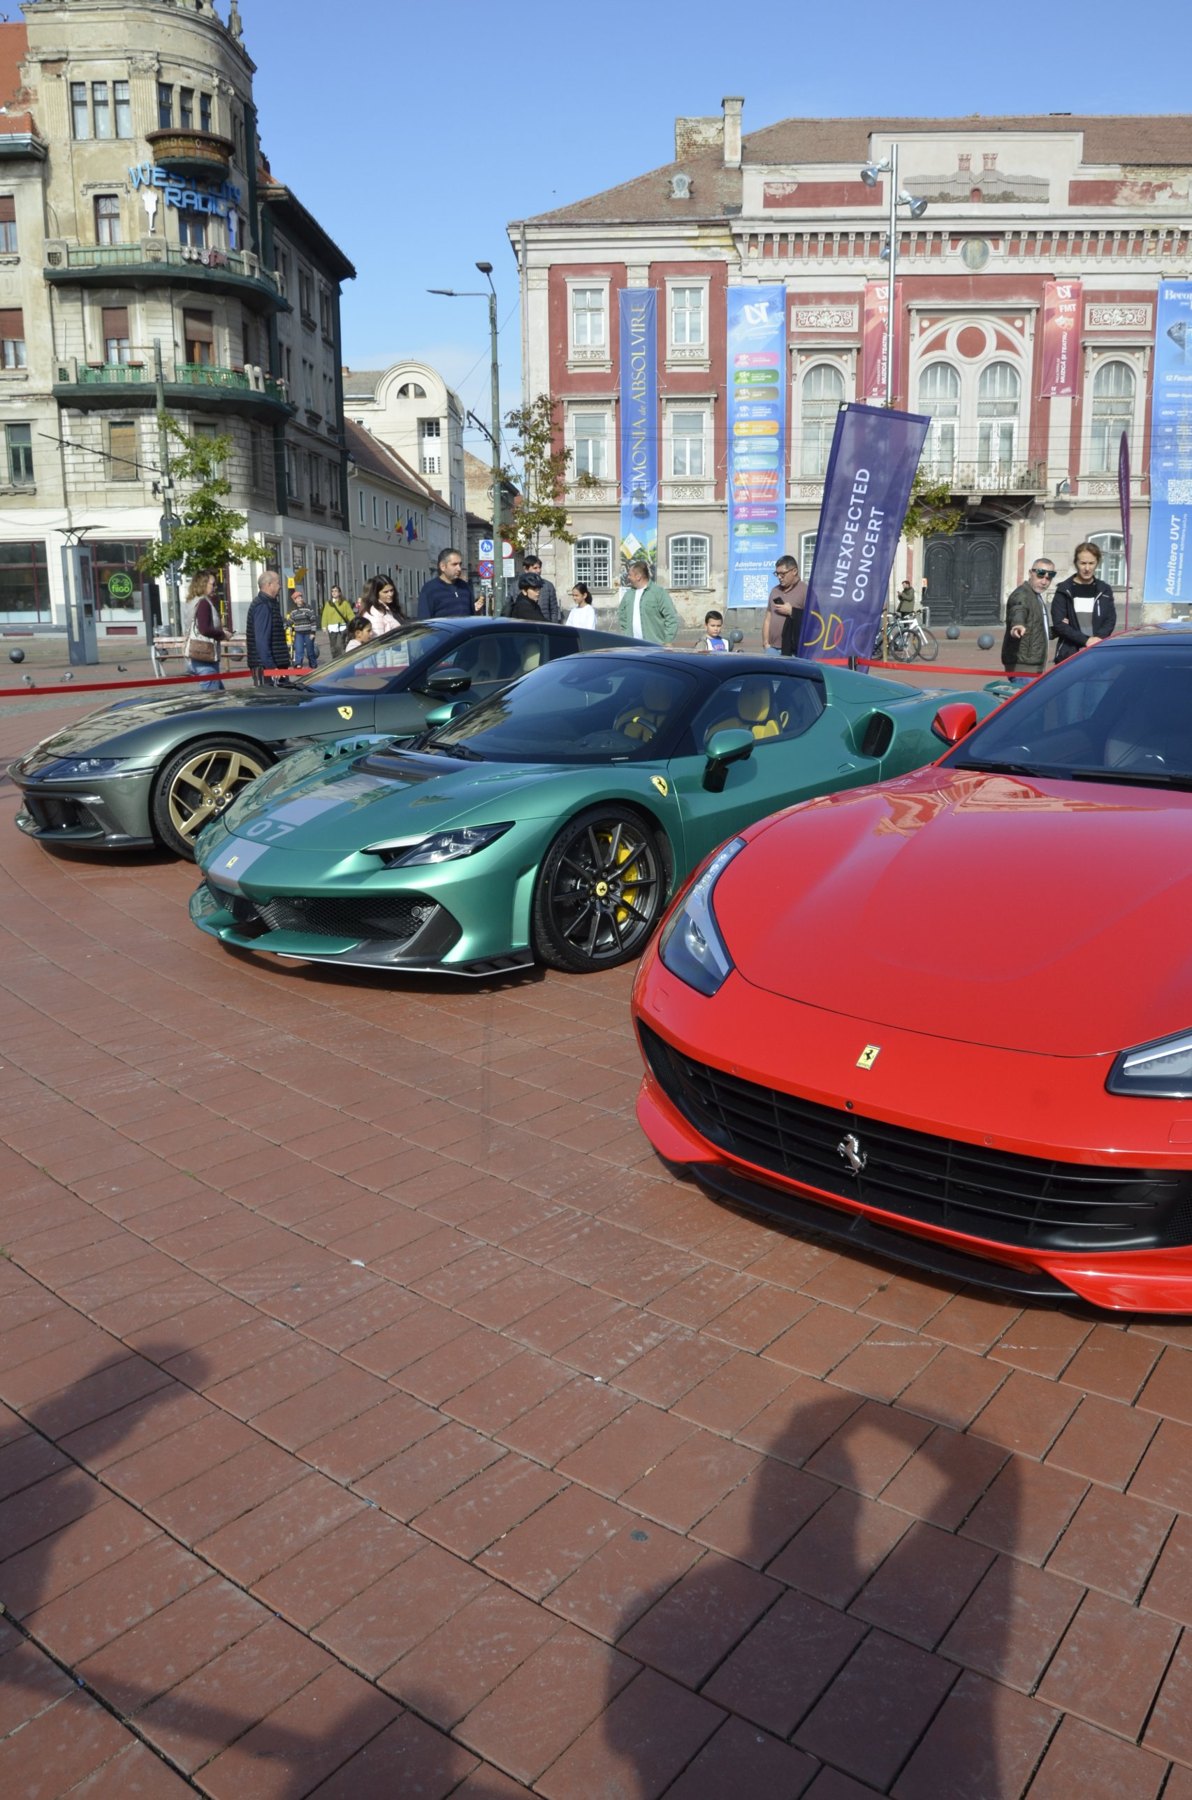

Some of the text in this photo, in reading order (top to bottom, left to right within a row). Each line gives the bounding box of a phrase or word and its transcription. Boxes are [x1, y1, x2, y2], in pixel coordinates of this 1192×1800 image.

[165, 187, 229, 219] RADIO
[1059, 303, 1077, 313] FMT
[631, 303, 647, 404] ABSOLVIRE
[830, 468, 870, 598] UNEXPECTED
[1170, 514, 1182, 540] UVT
[852, 506, 884, 602] CONCERT
[1165, 543, 1178, 595] Admitere
[246, 820, 296, 842] 07
